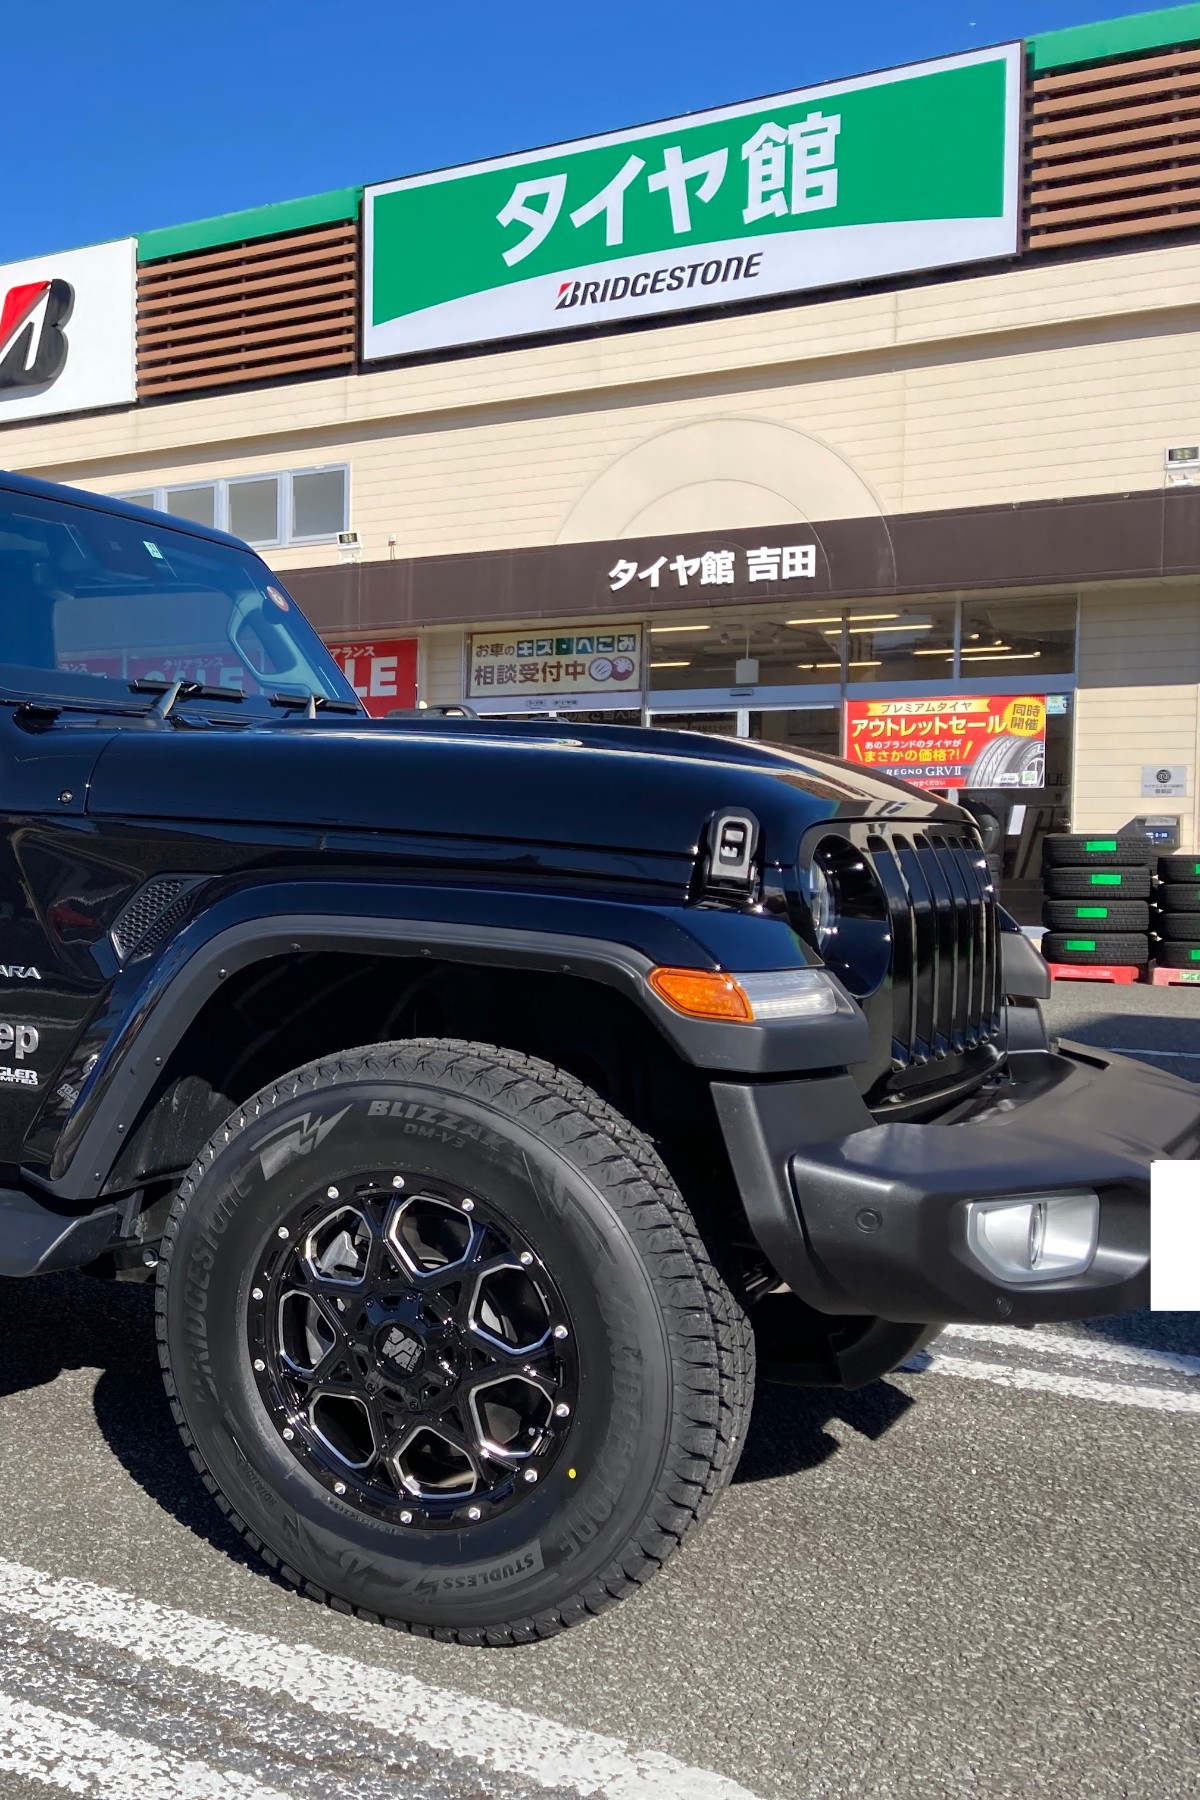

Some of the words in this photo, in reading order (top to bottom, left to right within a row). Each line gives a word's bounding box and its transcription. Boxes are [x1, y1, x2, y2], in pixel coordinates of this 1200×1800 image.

[495, 111, 841, 267] タイヤ館
[554, 252, 763, 310] BRIDGESTONE
[608, 550, 735, 591] タイヤ館
[746, 545, 816, 582] 吉田
[330, 646, 375, 659] アランス
[475, 634, 636, 658] お車のキズ・へこみ
[58, 663, 88, 673] ランス
[163, 657, 224, 671] クリアランス
[474, 660, 586, 686] 相談受付中
[344, 656, 398, 697] LE
[881, 702, 972, 714] プレミアムタイヤ
[1013, 704, 1041, 717] 同時
[851, 715, 1007, 737] アウトレットセール
[1010, 717, 1039, 731] 開催
[865, 738, 962, 749] あのブランドのタイヤが
[886, 768, 923, 777] REGNO
[403, 1122, 466, 1149] DM-V3
[442, 1552, 535, 1590] STUDLESS
